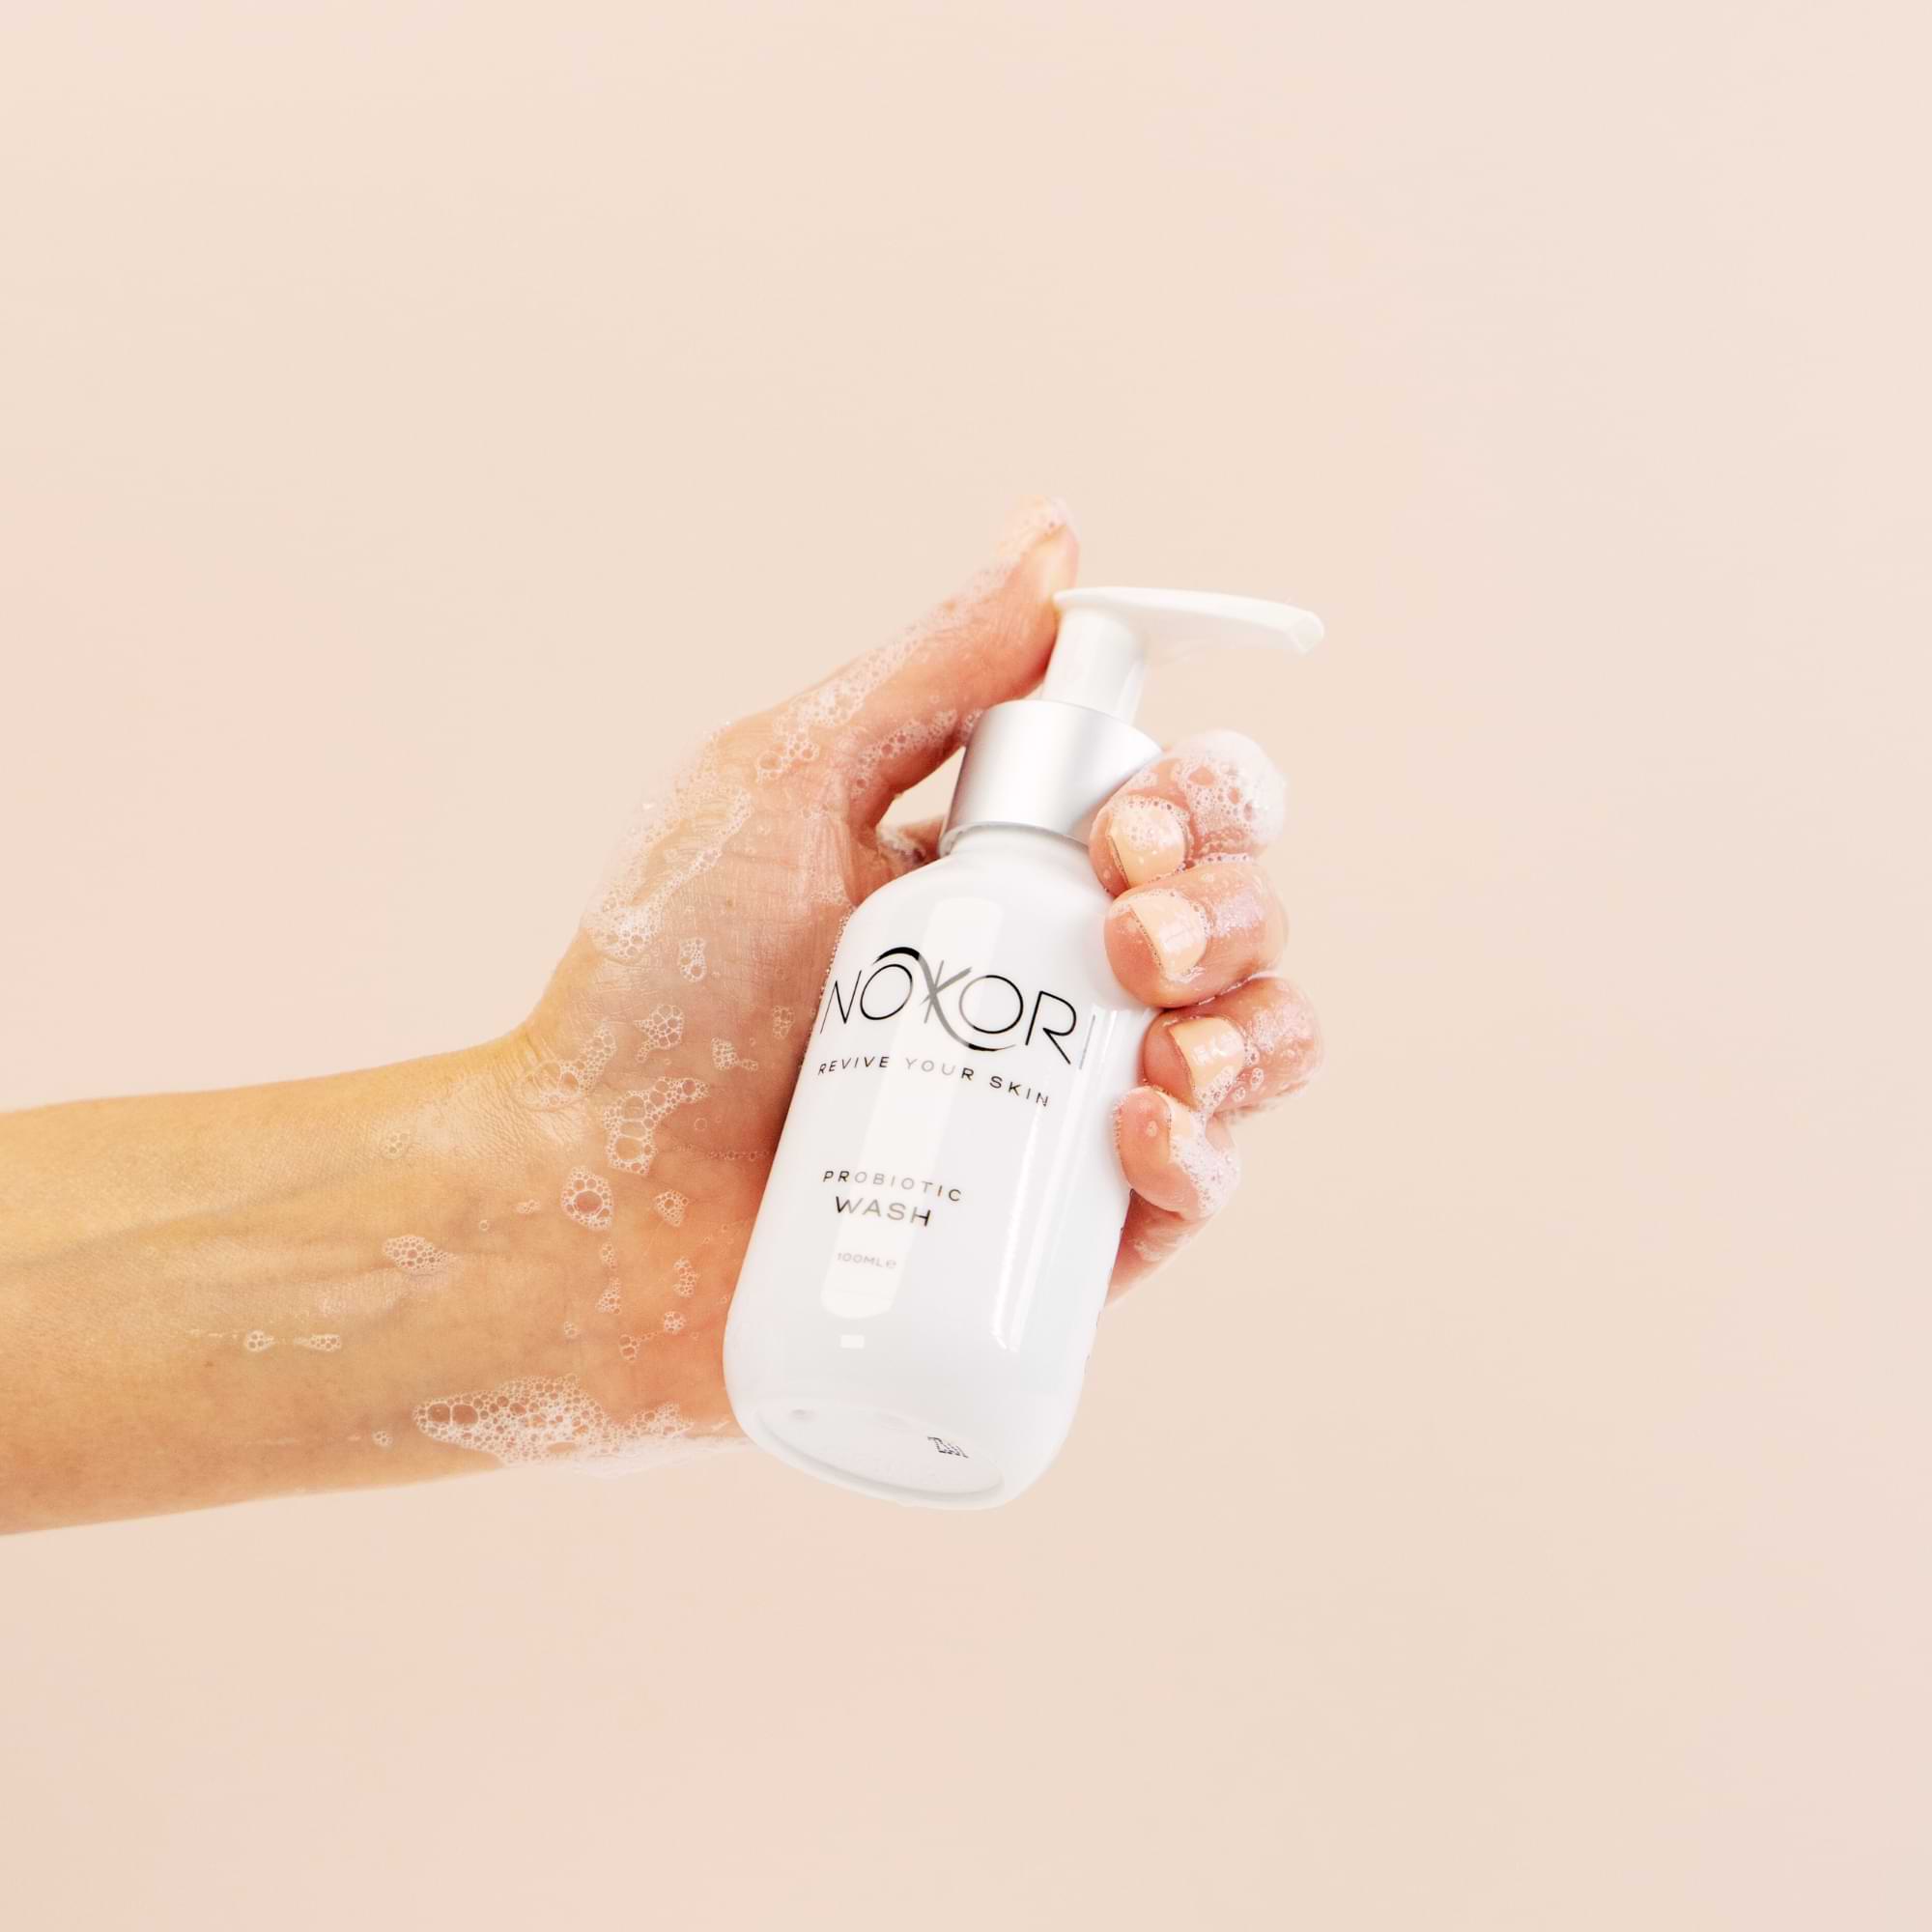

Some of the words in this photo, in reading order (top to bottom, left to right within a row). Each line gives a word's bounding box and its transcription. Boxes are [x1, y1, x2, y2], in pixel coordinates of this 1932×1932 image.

[820, 947, 1095, 1070] NOKORI
[818, 1056, 890, 1076] REVIVE
[905, 1058, 975, 1081] YOUR
[989, 1075, 1049, 1107] SKIN
[823, 1170, 961, 1202] PROBIOTIC
[836, 1196, 931, 1227] WASH
